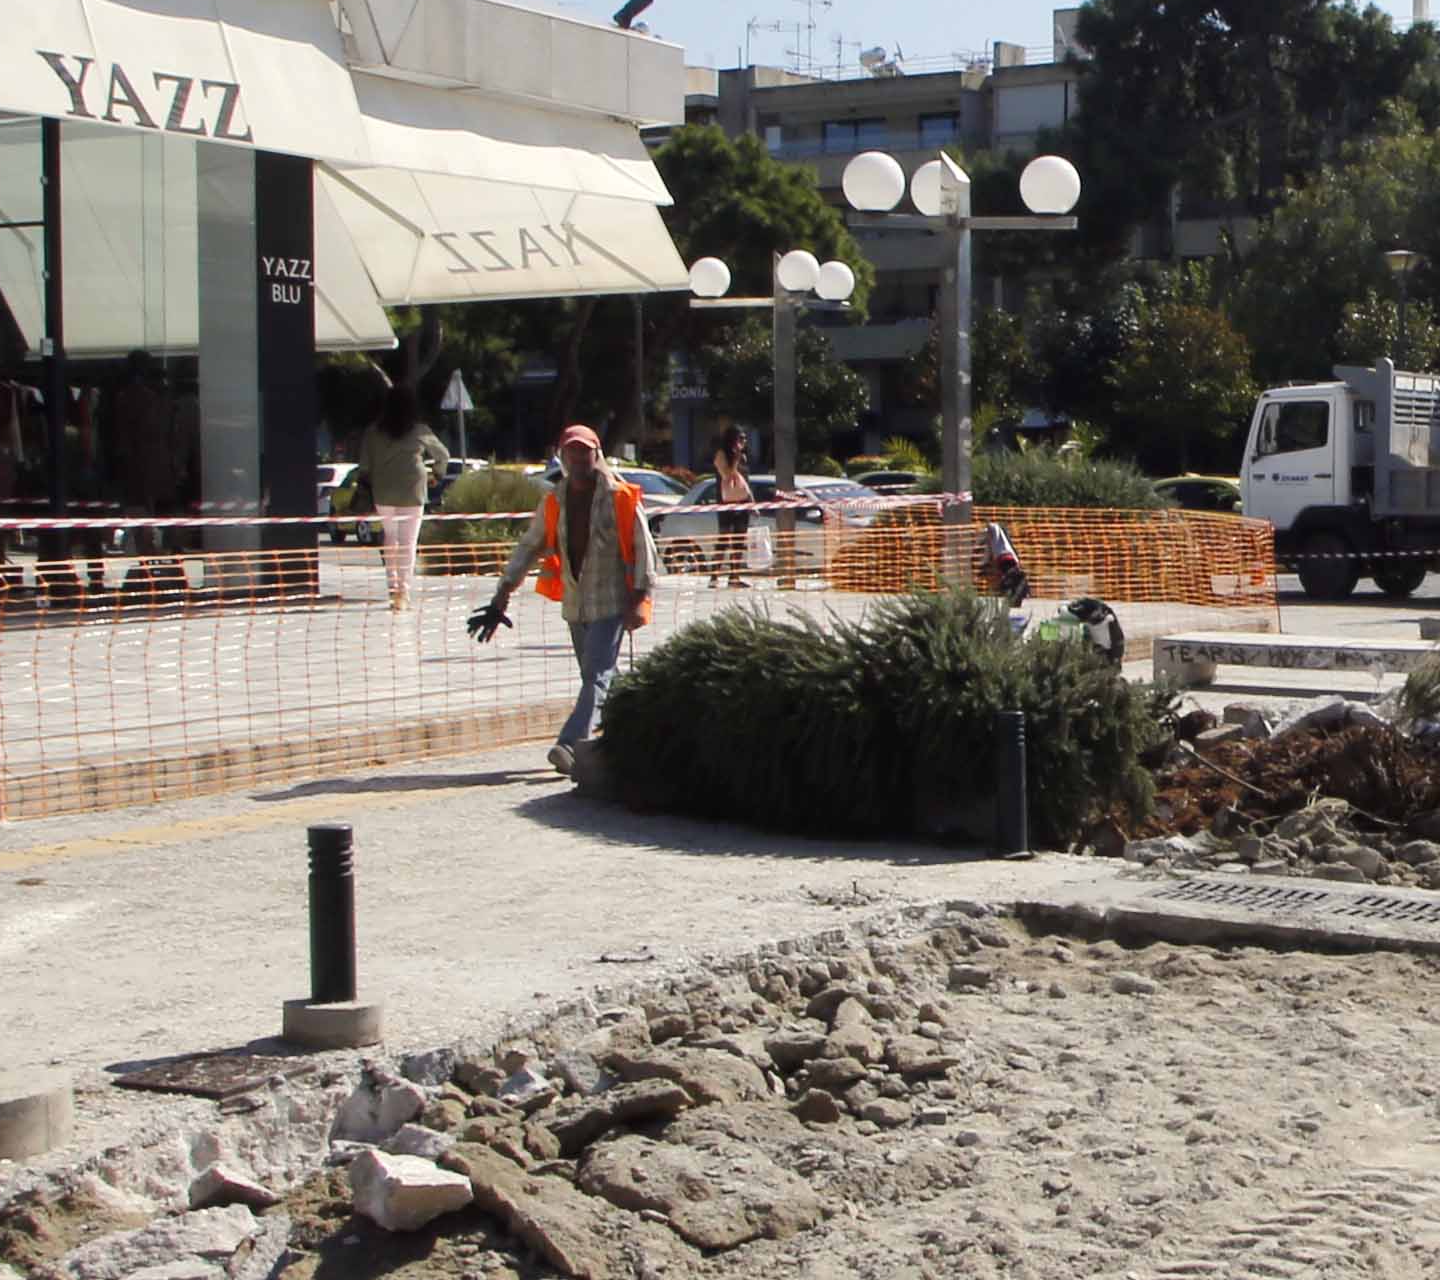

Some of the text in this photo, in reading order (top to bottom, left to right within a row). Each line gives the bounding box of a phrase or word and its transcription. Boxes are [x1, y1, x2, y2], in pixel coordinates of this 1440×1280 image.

[35, 50, 254, 144] YAZZ
[262, 256, 312, 279] YAZZ
[271, 283, 302, 304] BLU
